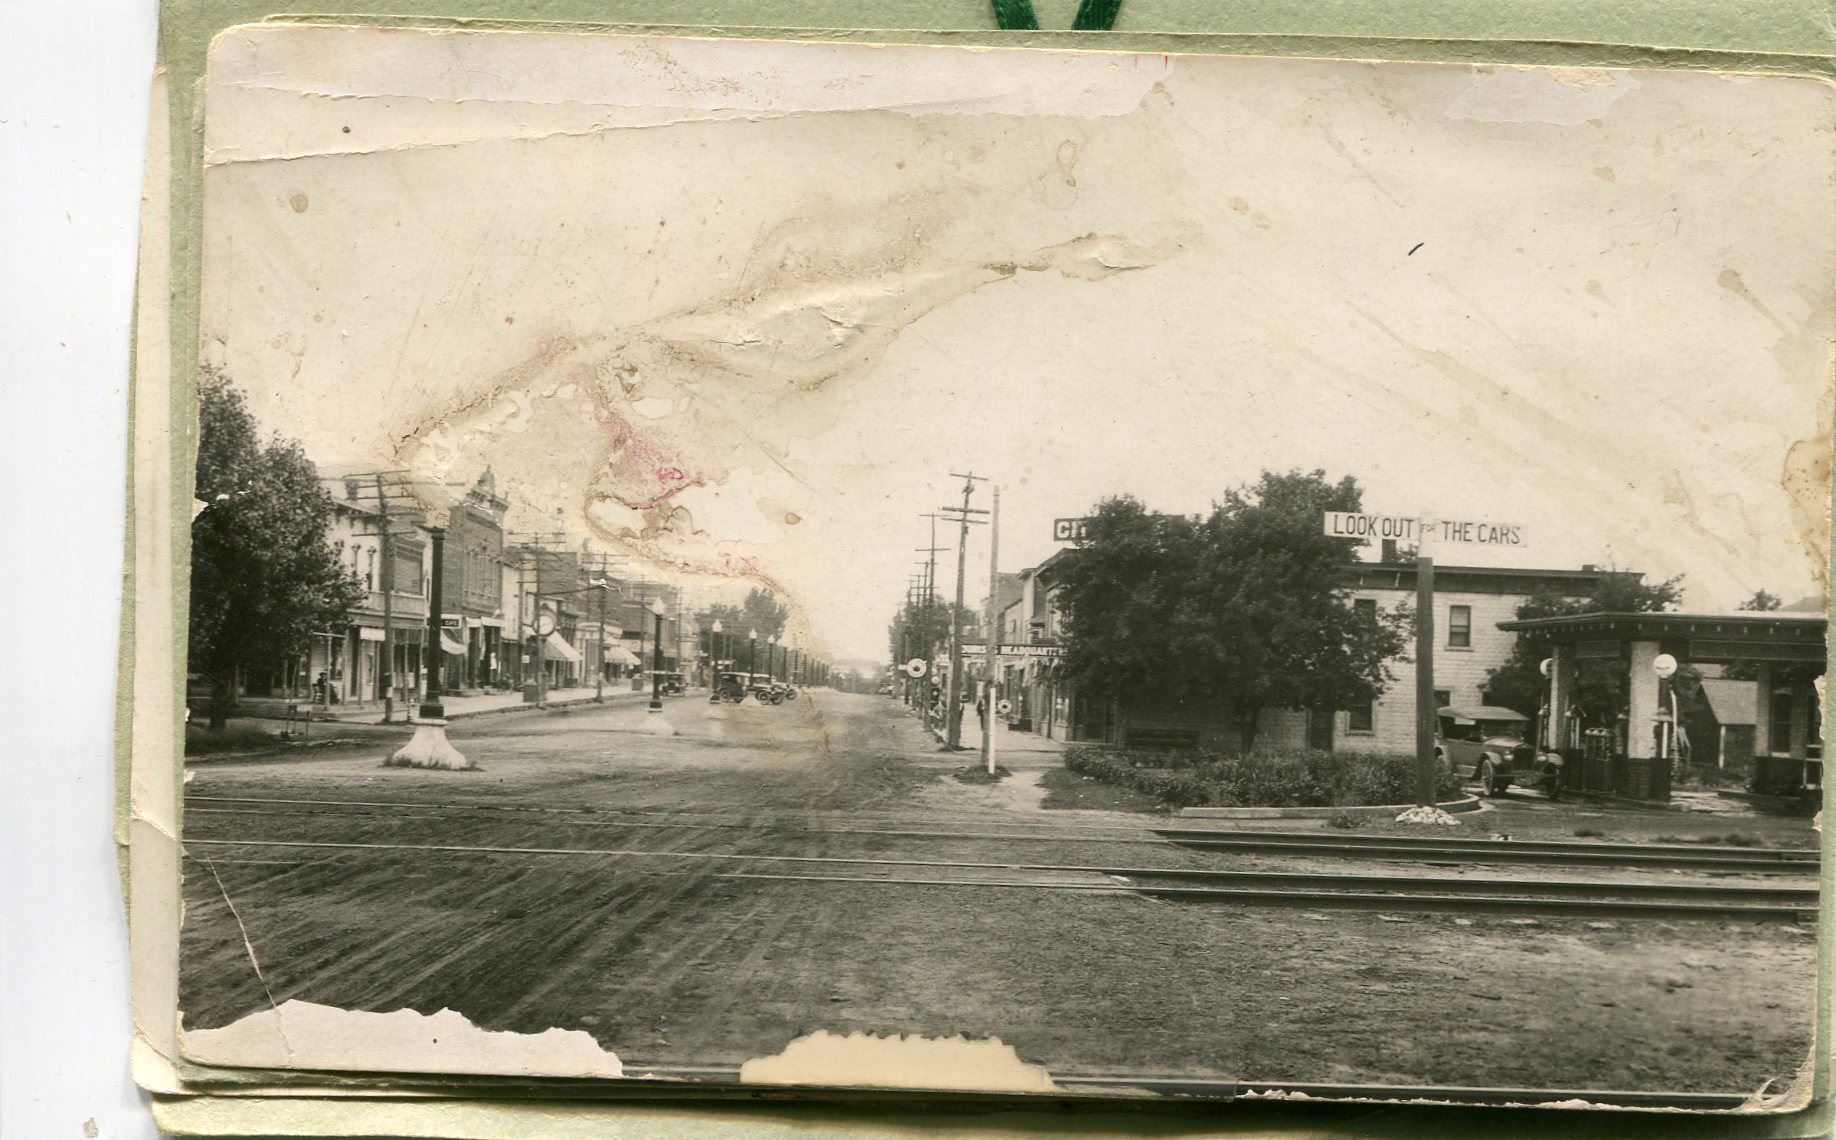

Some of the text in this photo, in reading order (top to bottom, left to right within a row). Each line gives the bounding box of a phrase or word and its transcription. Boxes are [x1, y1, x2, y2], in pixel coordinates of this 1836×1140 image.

[1333, 514, 1377, 537] LOOK
[1382, 517, 1414, 539] OUT
[1442, 520, 1474, 542] THE
[1477, 523, 1521, 545] CARS
